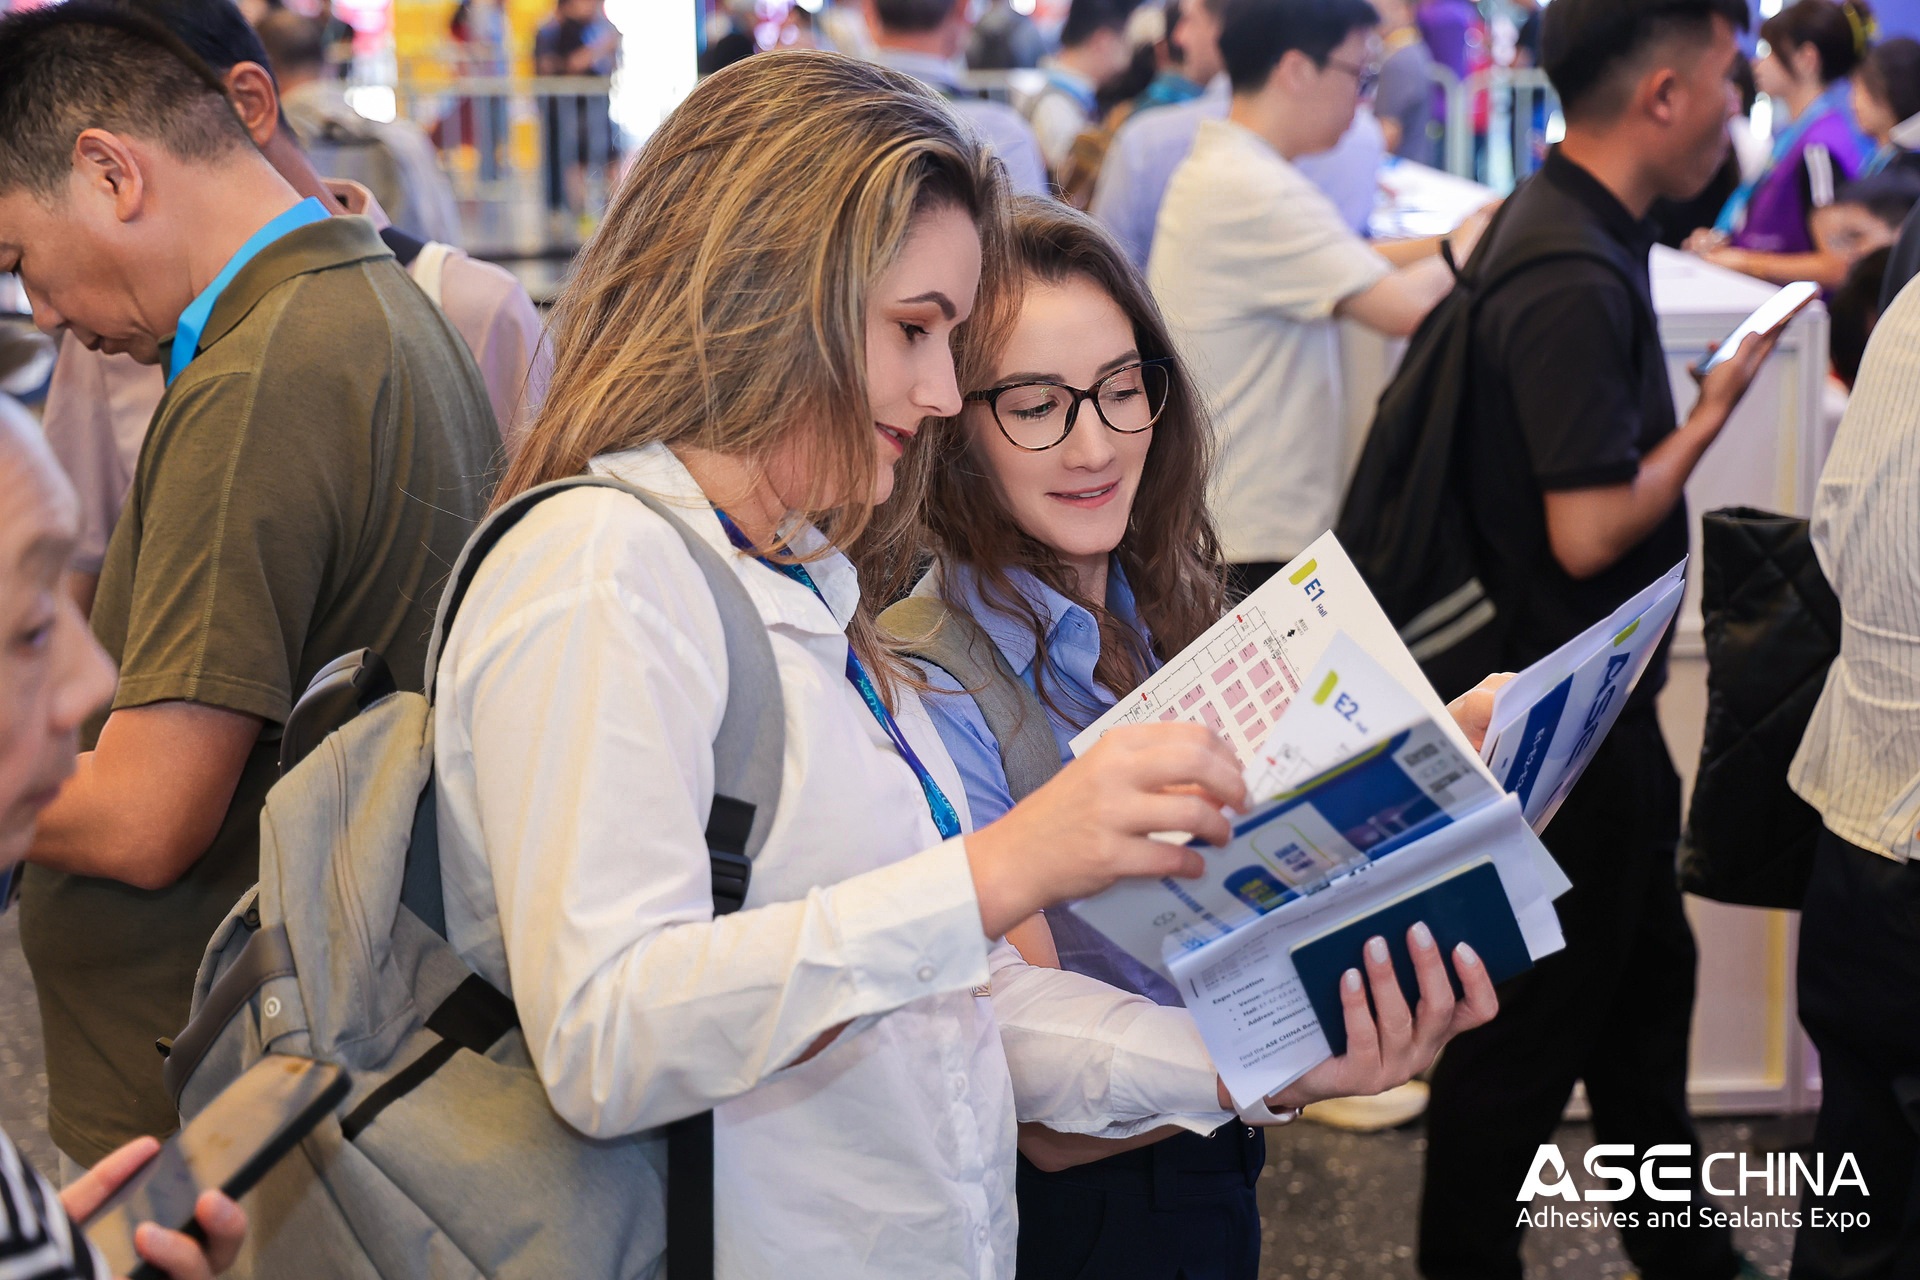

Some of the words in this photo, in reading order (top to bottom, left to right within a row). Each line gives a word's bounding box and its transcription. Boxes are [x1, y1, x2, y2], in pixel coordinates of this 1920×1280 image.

[1303, 578, 1325, 602] E1
[1316, 603, 1328, 618] Hall
[1333, 691, 1359, 722] E2
[1565, 651, 1631, 769] ASE
[1212, 993, 1231, 1005] Expo
[1232, 977, 1265, 996] Location
[1272, 1007, 1306, 1027] Admission
[1253, 1047, 1264, 1056] the
[1264, 1039, 1278, 1050] ASE
[1278, 1027, 1302, 1043] CHINA
